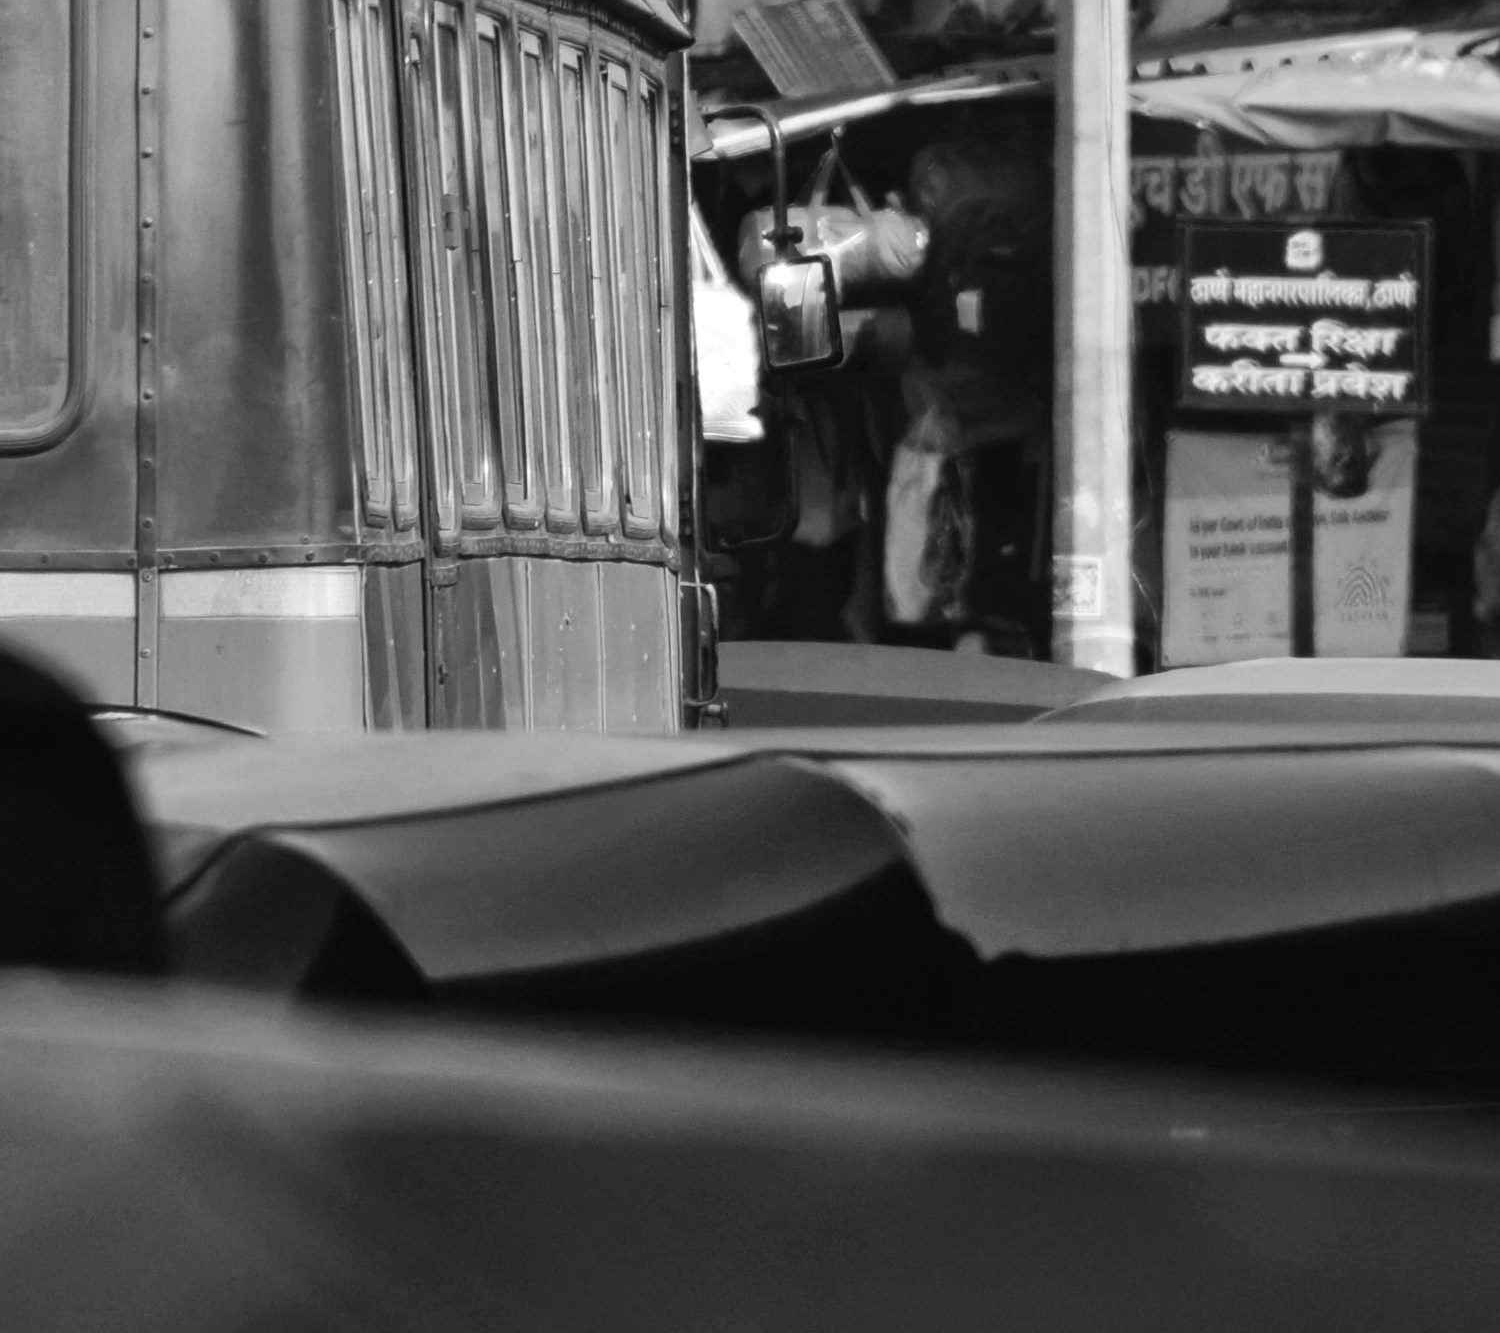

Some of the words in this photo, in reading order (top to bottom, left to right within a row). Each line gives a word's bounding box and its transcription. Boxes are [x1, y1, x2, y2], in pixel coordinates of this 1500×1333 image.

[1190, 266, 1231, 306] ठाणे
[1372, 268, 1417, 311] ठाणे
[1308, 360, 1413, 402] प्रवेश
